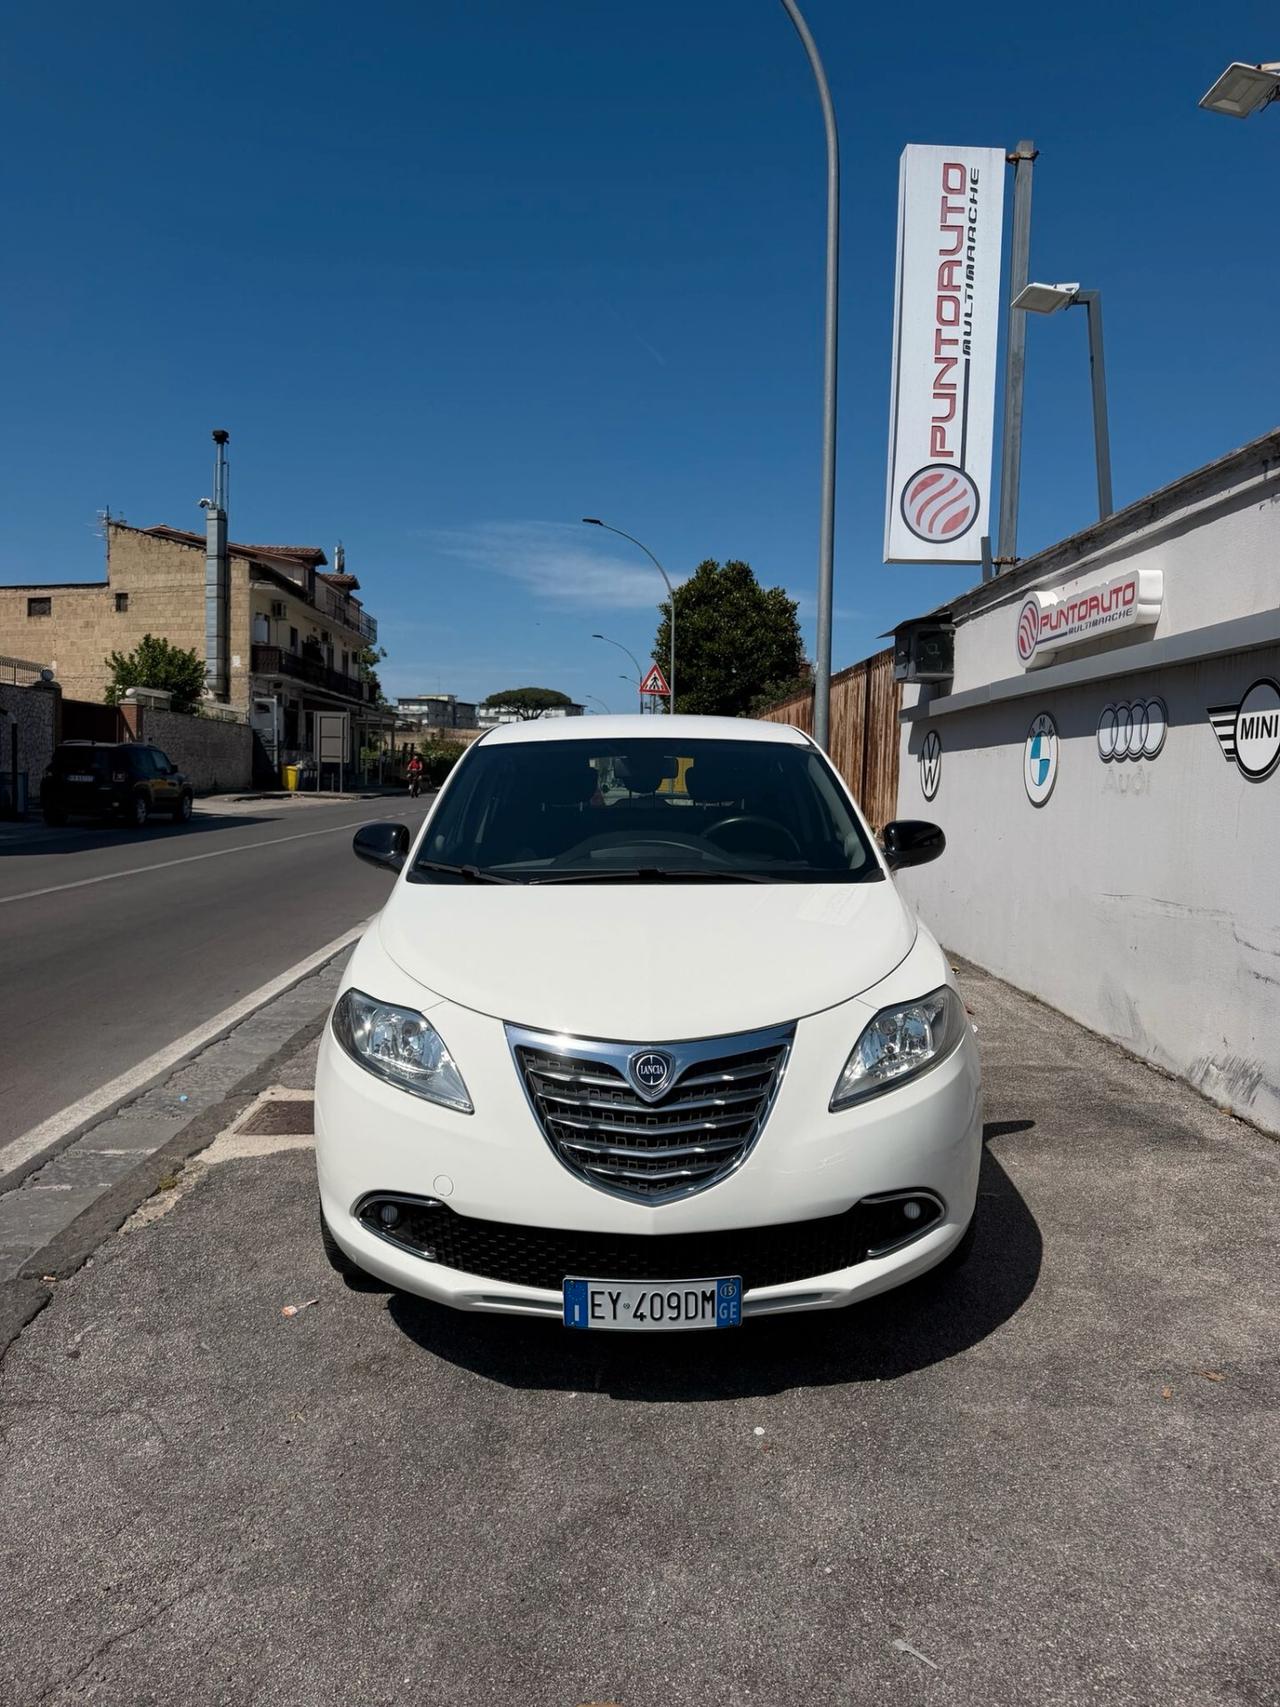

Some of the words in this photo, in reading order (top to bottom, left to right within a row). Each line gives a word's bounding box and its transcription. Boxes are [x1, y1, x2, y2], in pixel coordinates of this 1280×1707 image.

[962, 167, 980, 356] MULTIMARCHE
[930, 162, 967, 458] PUNTOAUTO
[1039, 581, 1136, 635] PUNTOAUTO
[1067, 607, 1134, 635] MULTIMARCHE
[1240, 714, 1279, 741] MINI
[640, 1064, 664, 1075] LANCIA
[590, 1290, 622, 1321] EY
[632, 1289, 716, 1322] 409DM
[719, 1301, 737, 1320] GE
